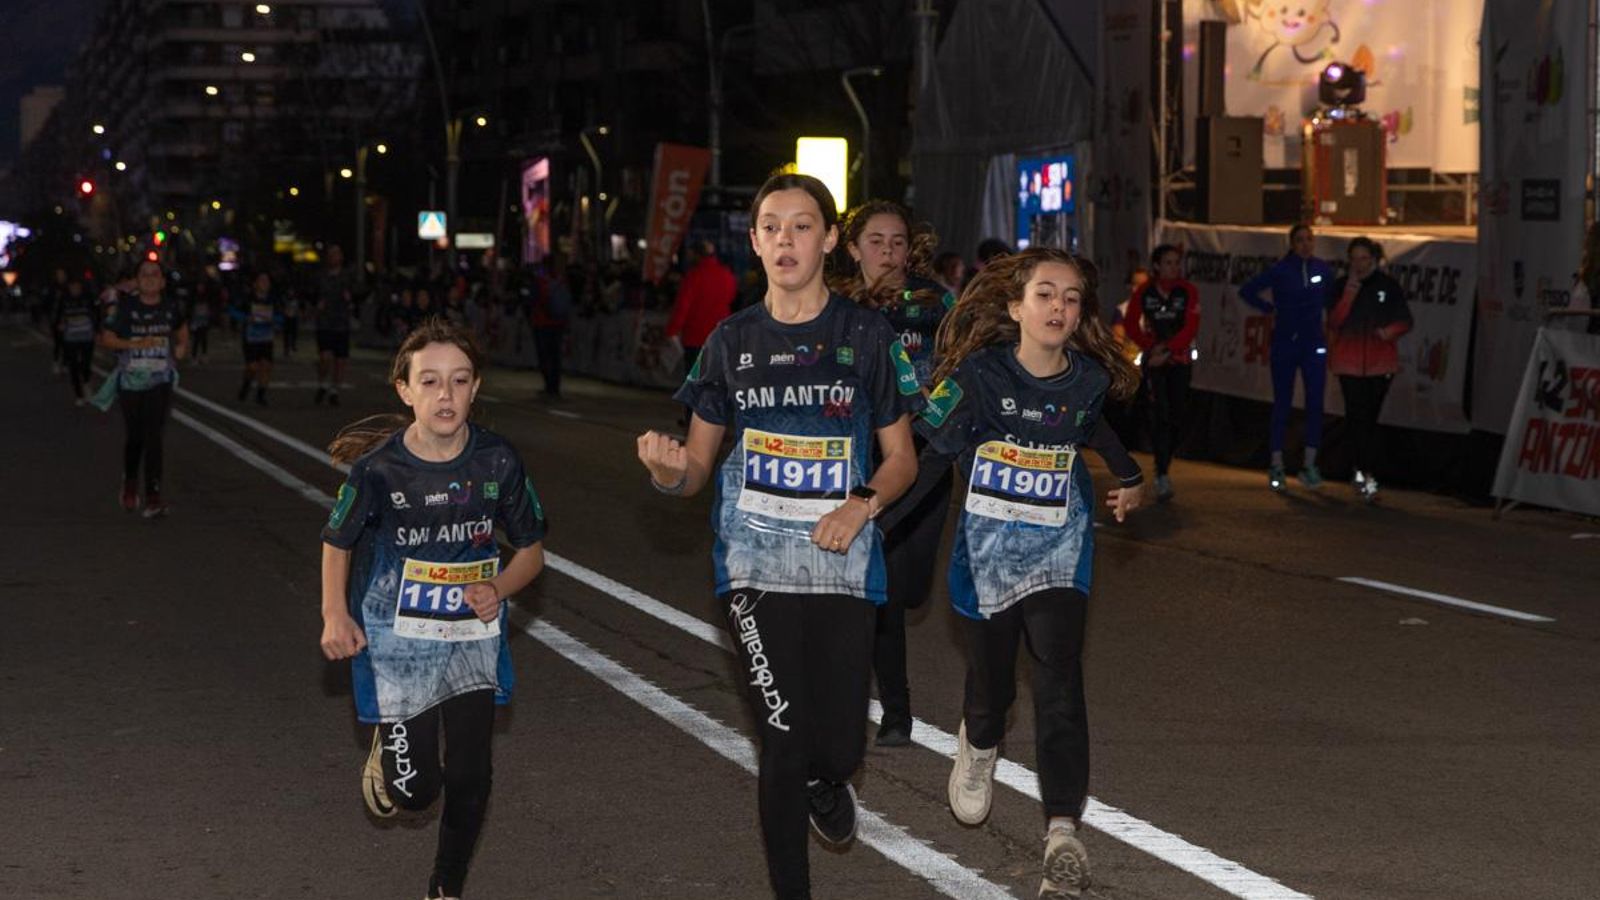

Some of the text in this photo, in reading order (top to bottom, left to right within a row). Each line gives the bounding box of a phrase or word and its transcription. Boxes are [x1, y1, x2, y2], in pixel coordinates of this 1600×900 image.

[735, 379, 855, 411] SAN ANTÓN
[764, 436, 785, 453] 42
[748, 455, 843, 488] 11911
[977, 461, 1068, 497] 11907
[396, 525, 430, 547] SAN
[404, 583, 464, 612] 119
[384, 720, 418, 798] Acrob
